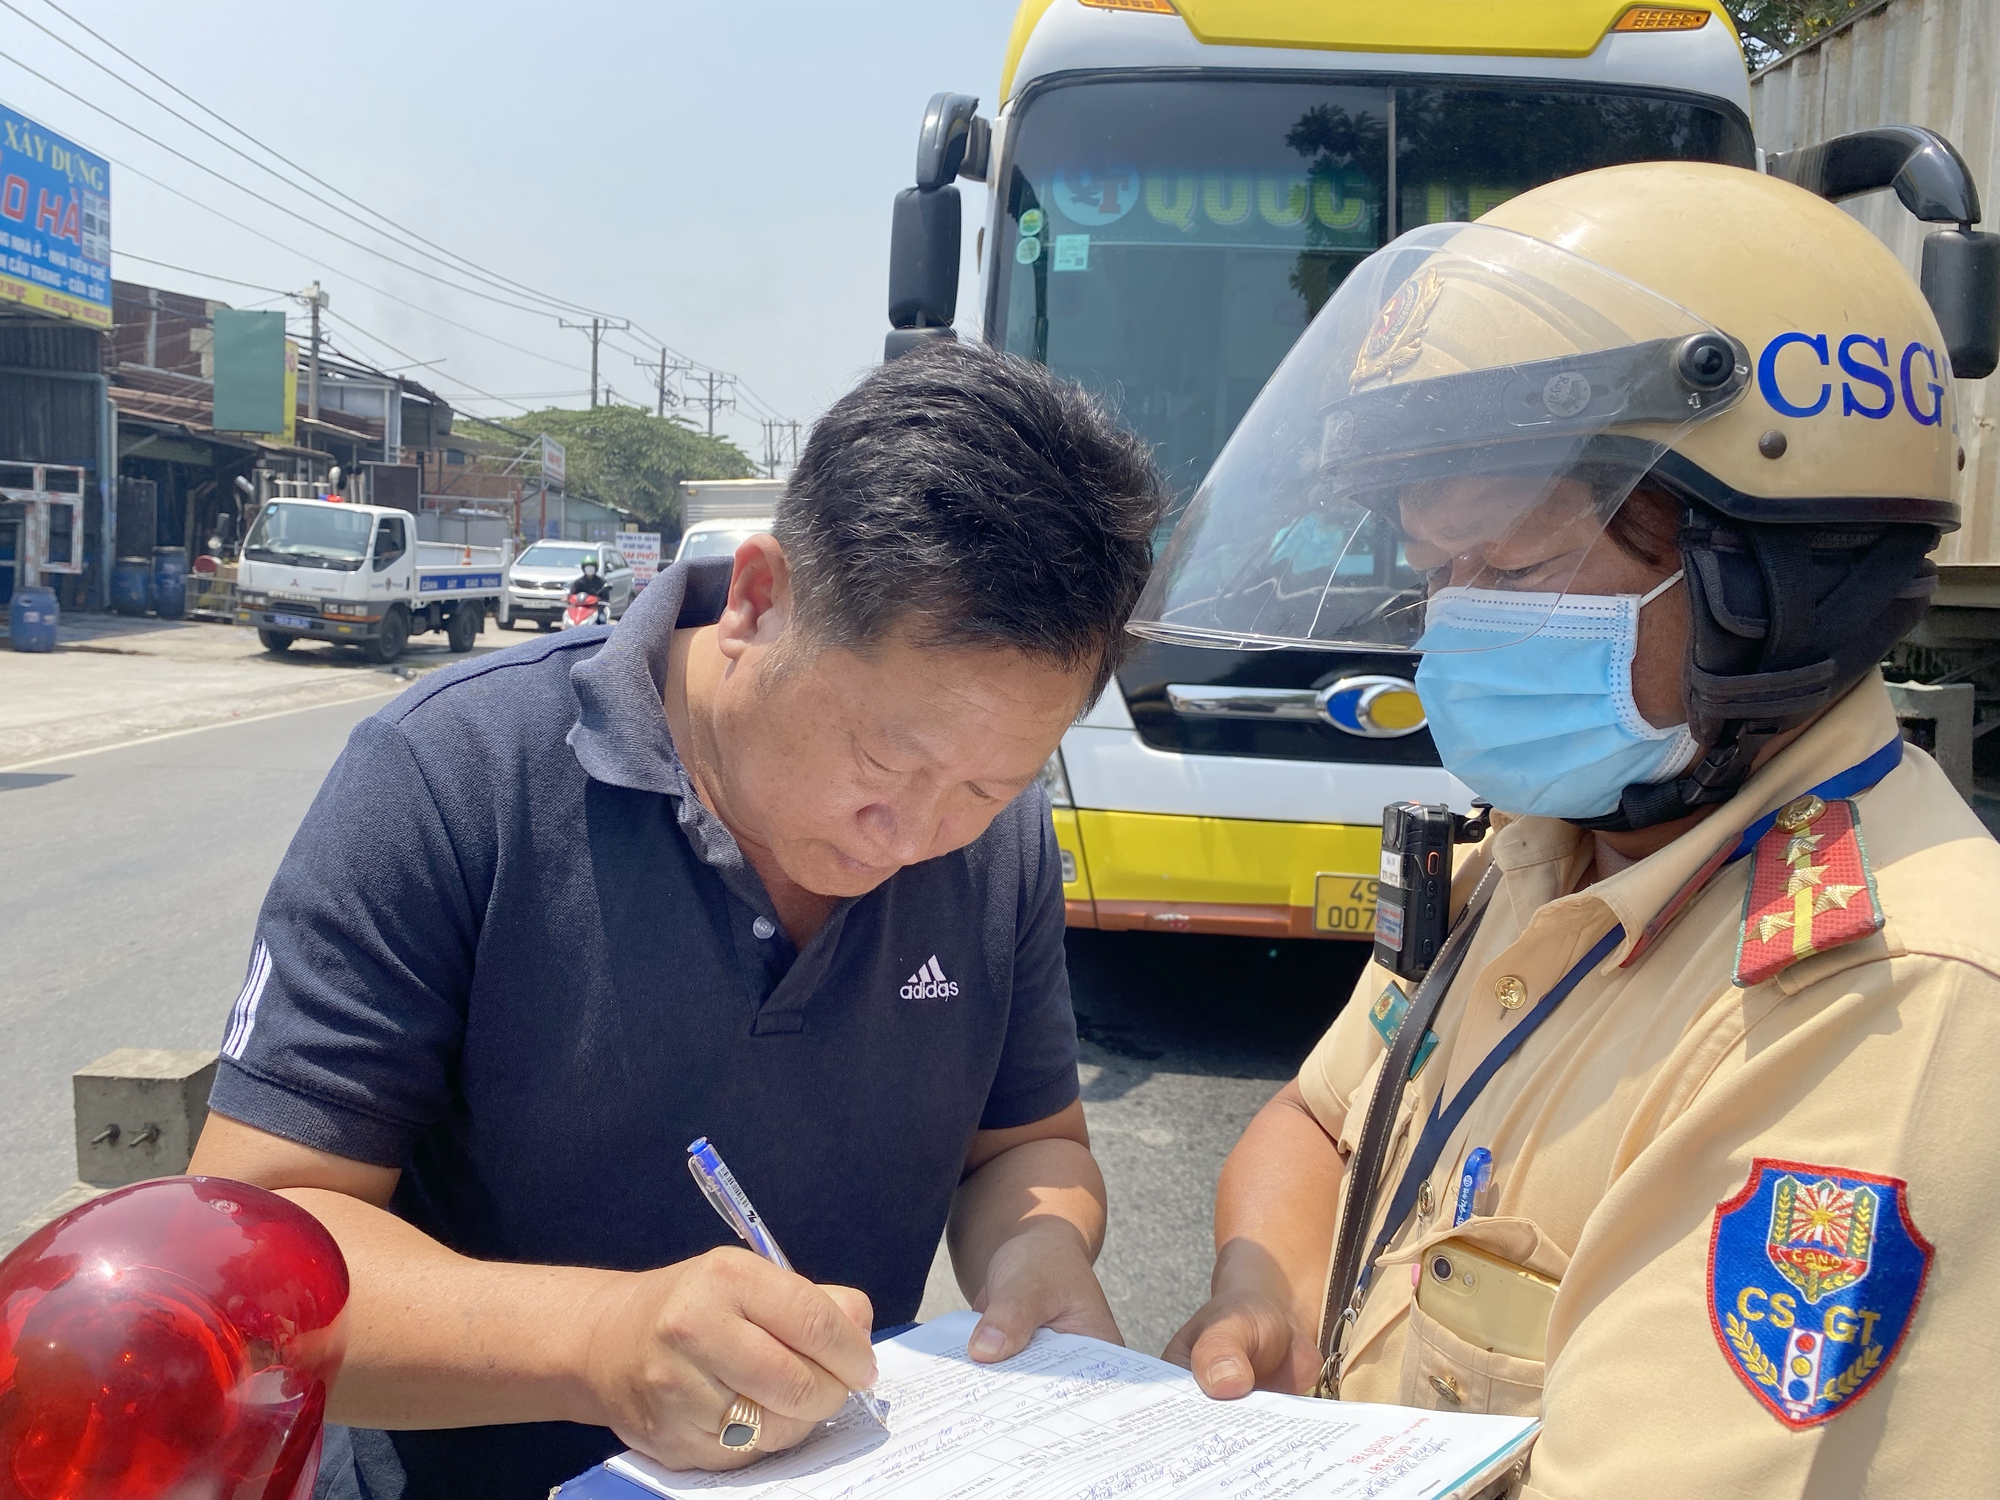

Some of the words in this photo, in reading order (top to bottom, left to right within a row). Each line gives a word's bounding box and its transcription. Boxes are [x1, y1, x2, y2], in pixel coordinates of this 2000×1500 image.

[4, 119, 48, 164] XÂY
[51, 142, 104, 192] DỰNG
[0, 173, 29, 223] O
[36, 187, 81, 246] HÀ
[1757, 331, 1960, 435] CSG
[900, 980, 959, 1000] adidas
[1791, 1249, 1843, 1271] CAND
[1736, 1286, 1797, 1329] CS
[1823, 1304, 1882, 1347] GT
